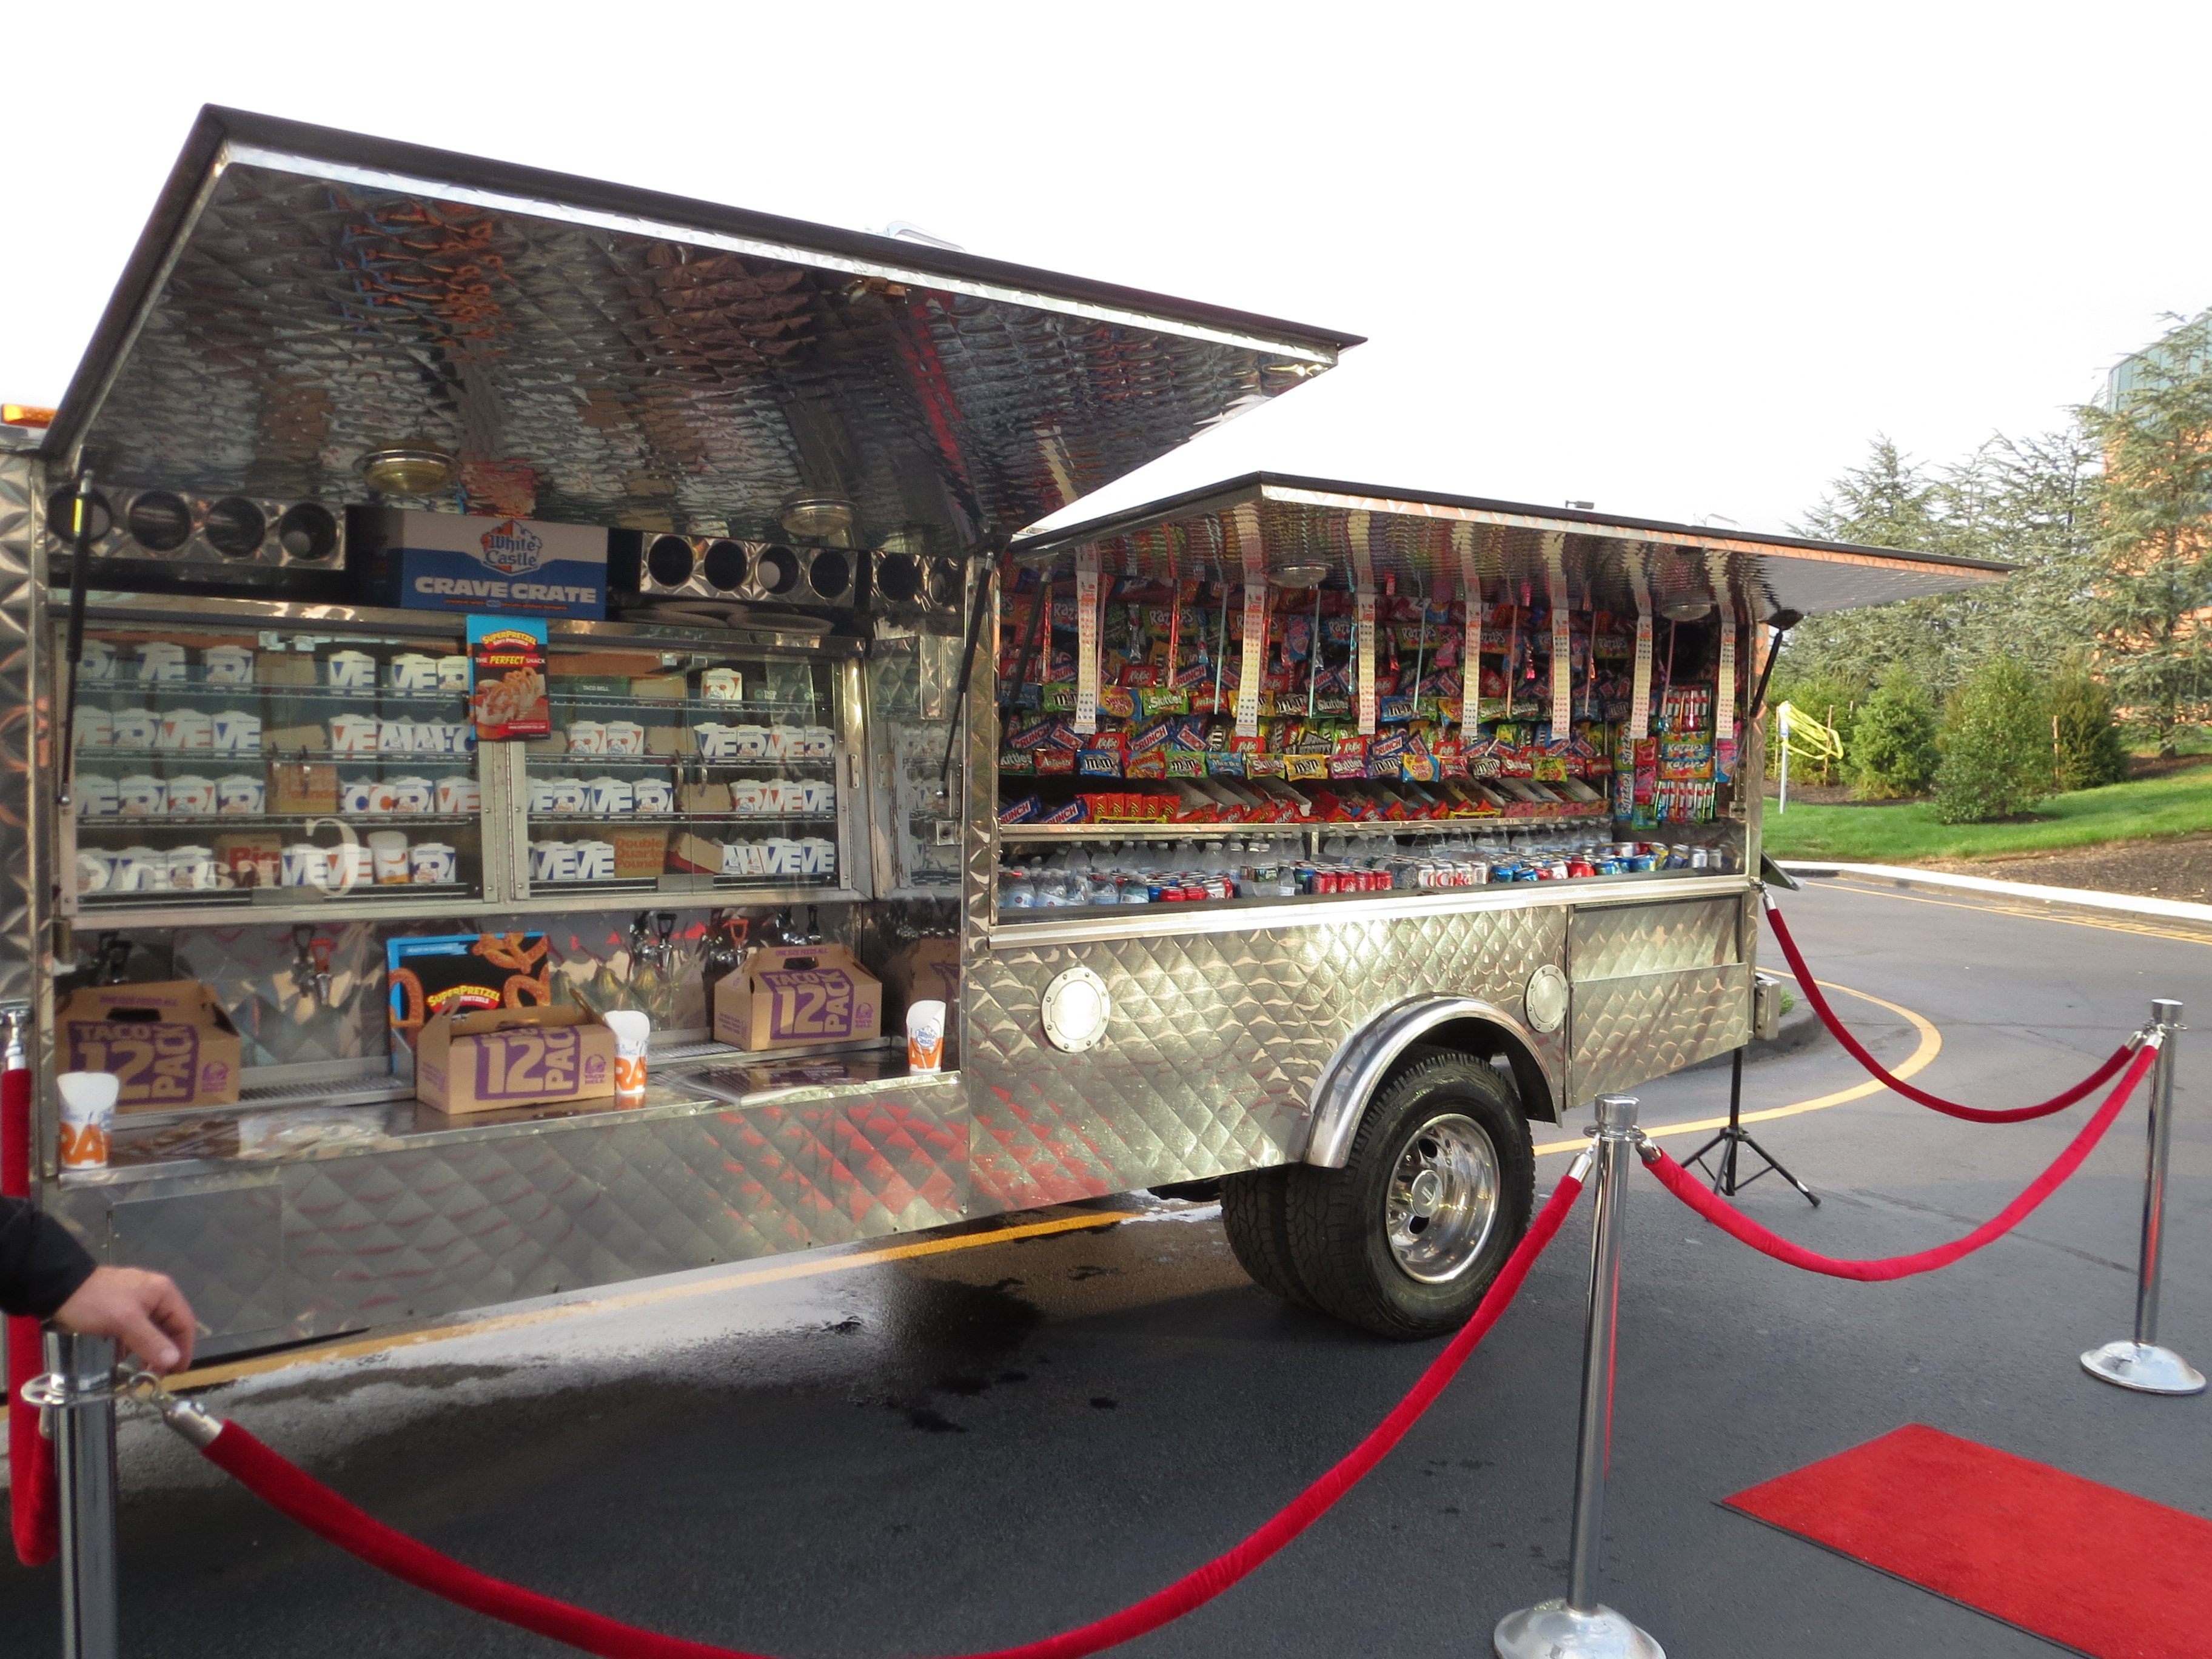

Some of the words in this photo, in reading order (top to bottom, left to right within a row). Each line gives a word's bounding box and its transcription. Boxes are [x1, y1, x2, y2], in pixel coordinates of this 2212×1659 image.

[490, 534, 536, 551] White
[486, 551, 537, 567] Castle
[415, 576, 508, 598] CRAVE
[511, 583, 597, 604] CRATE
[1149, 608, 1193, 626] Razes
[489, 655, 525, 665] PERFECT
[1150, 694, 1183, 709] Skittles
[1316, 699, 1350, 712] Skittles
[1133, 725, 1167, 752] CRUNCH
[1000, 753, 1033, 766] kittles
[1333, 758, 1364, 773] Skittles
[766, 972, 820, 987] TACO
[775, 984, 827, 1035] 12
[823, 971, 851, 1032] PACK
[152, 1025, 194, 1098] PAC
[481, 1036, 545, 1093] 12
[545, 1026, 575, 1090] PAC
